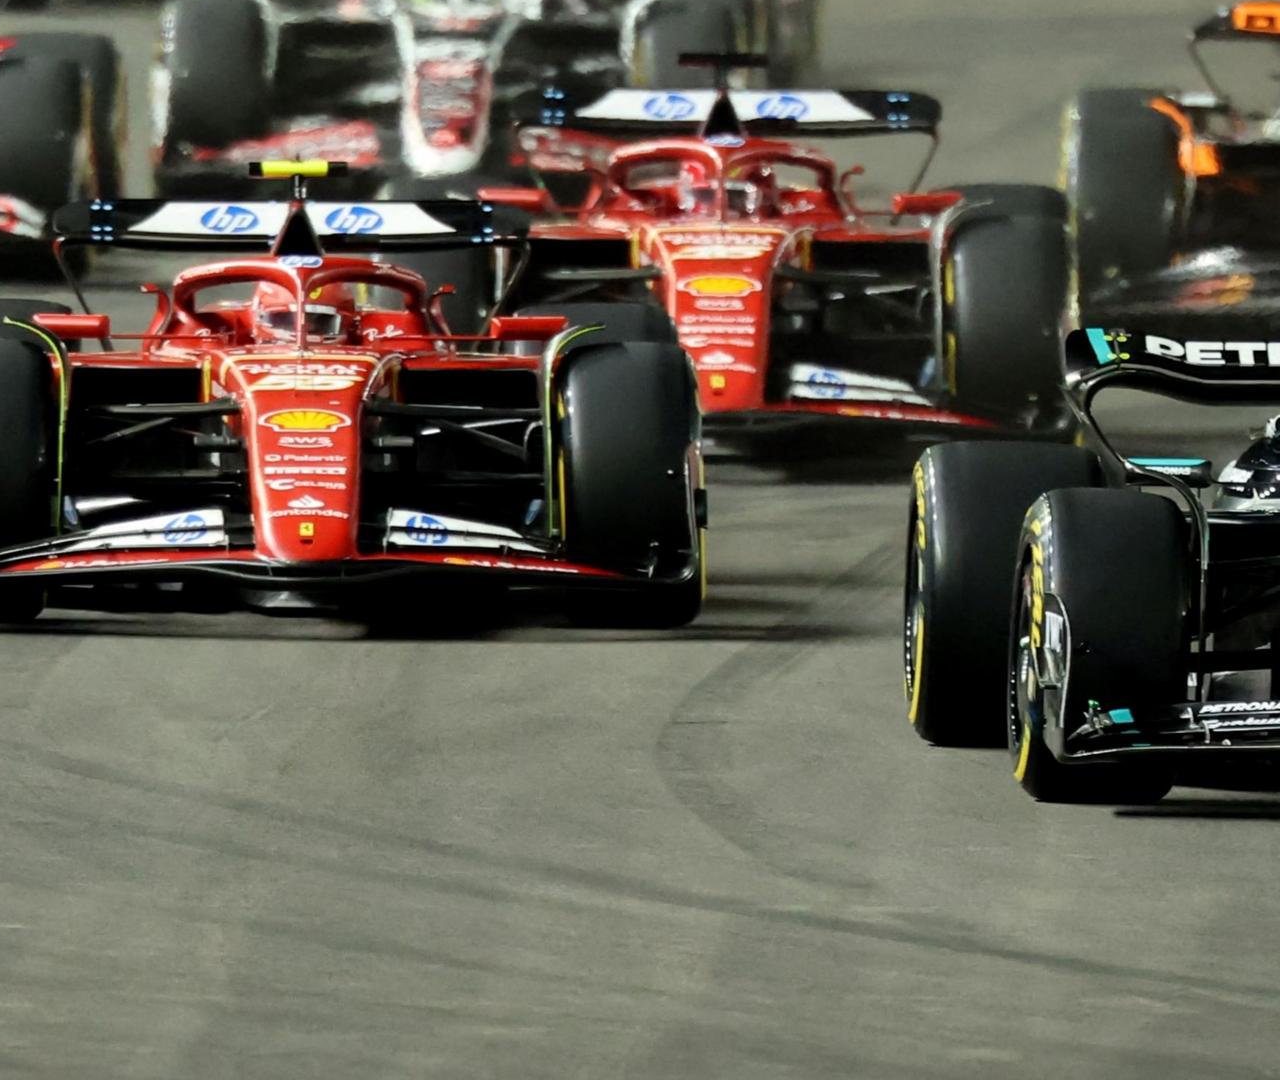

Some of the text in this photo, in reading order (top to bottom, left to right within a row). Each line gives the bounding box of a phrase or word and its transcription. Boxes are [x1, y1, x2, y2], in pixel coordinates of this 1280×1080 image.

[647, 94, 693, 120] hp
[760, 95, 805, 121] hp
[205, 206, 256, 232] hp
[329, 206, 380, 233] hp
[283, 454, 347, 462] Palantir
